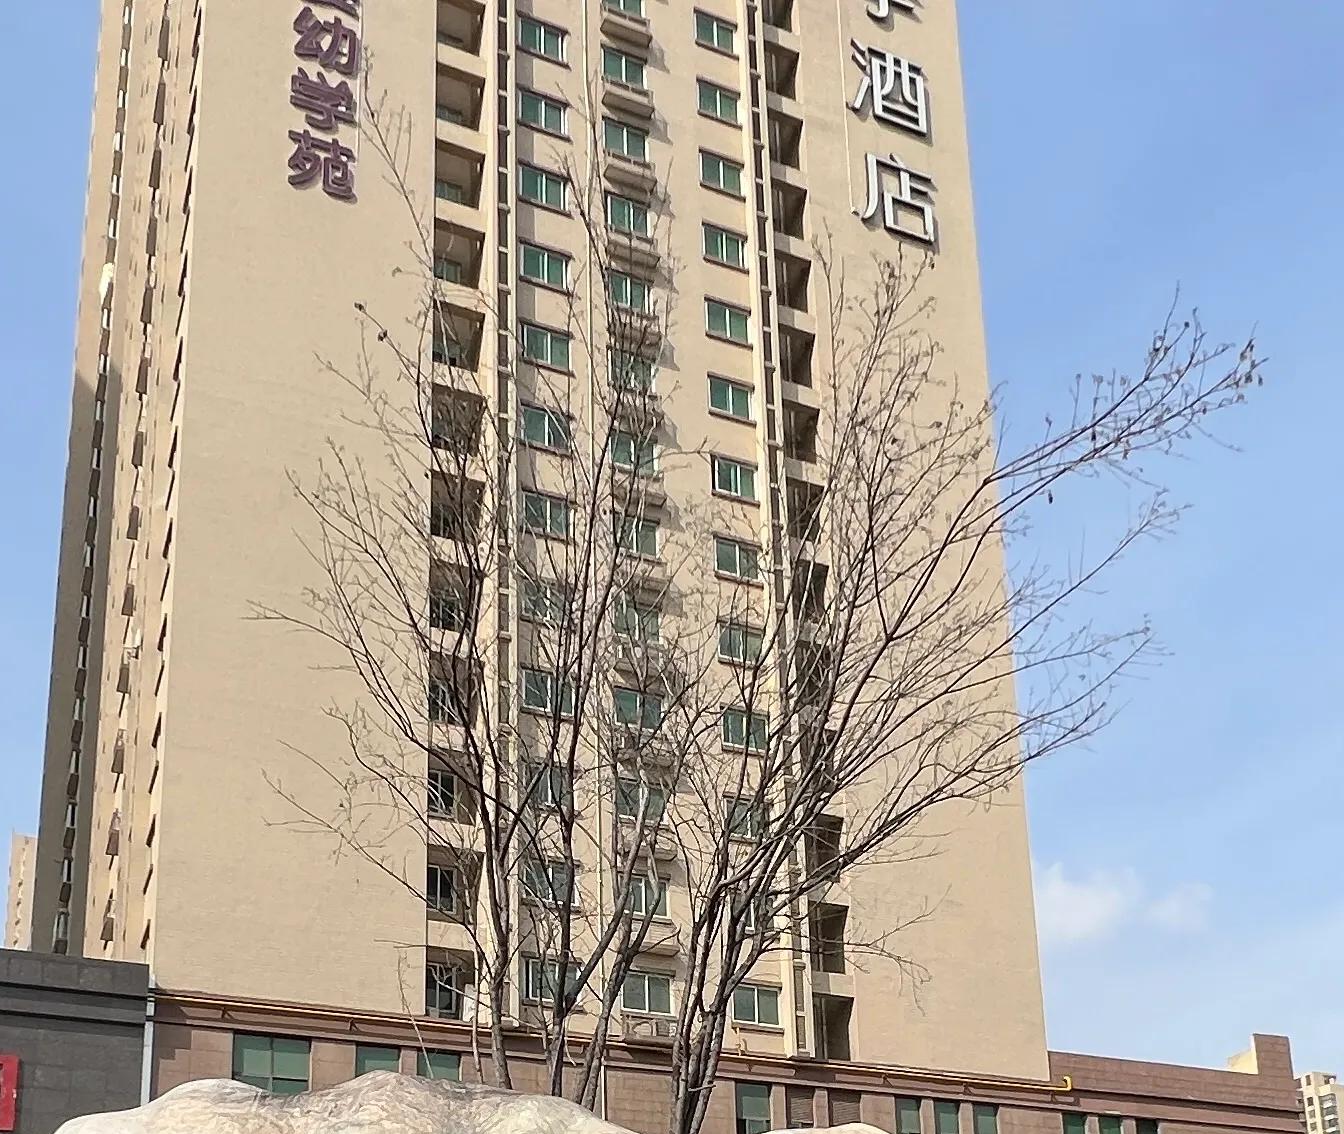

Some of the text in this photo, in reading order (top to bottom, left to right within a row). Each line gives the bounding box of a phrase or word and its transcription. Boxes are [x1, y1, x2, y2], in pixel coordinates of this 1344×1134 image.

[288, 0, 360, 201] 幼学苑
[850, 0, 937, 243] 酒店
